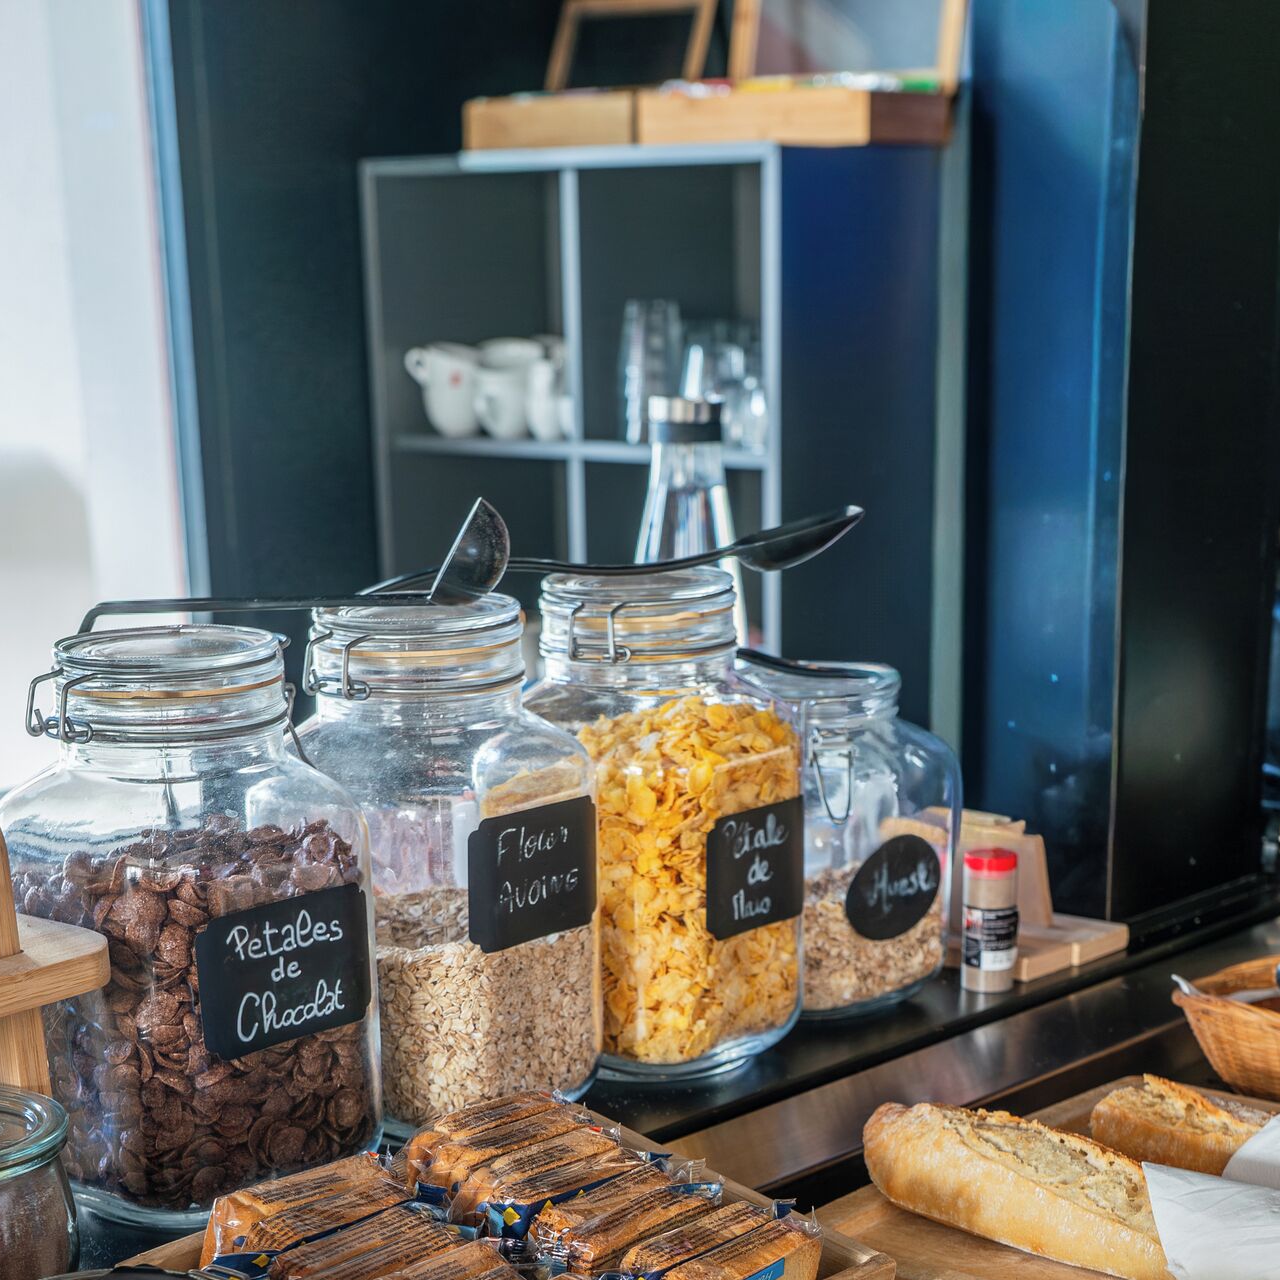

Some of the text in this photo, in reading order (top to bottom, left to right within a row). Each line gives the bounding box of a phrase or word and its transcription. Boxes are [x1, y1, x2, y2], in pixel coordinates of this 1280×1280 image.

[748, 851, 774, 886] de
[270, 955, 303, 983] de
[236, 977, 346, 1043] Chocolat
